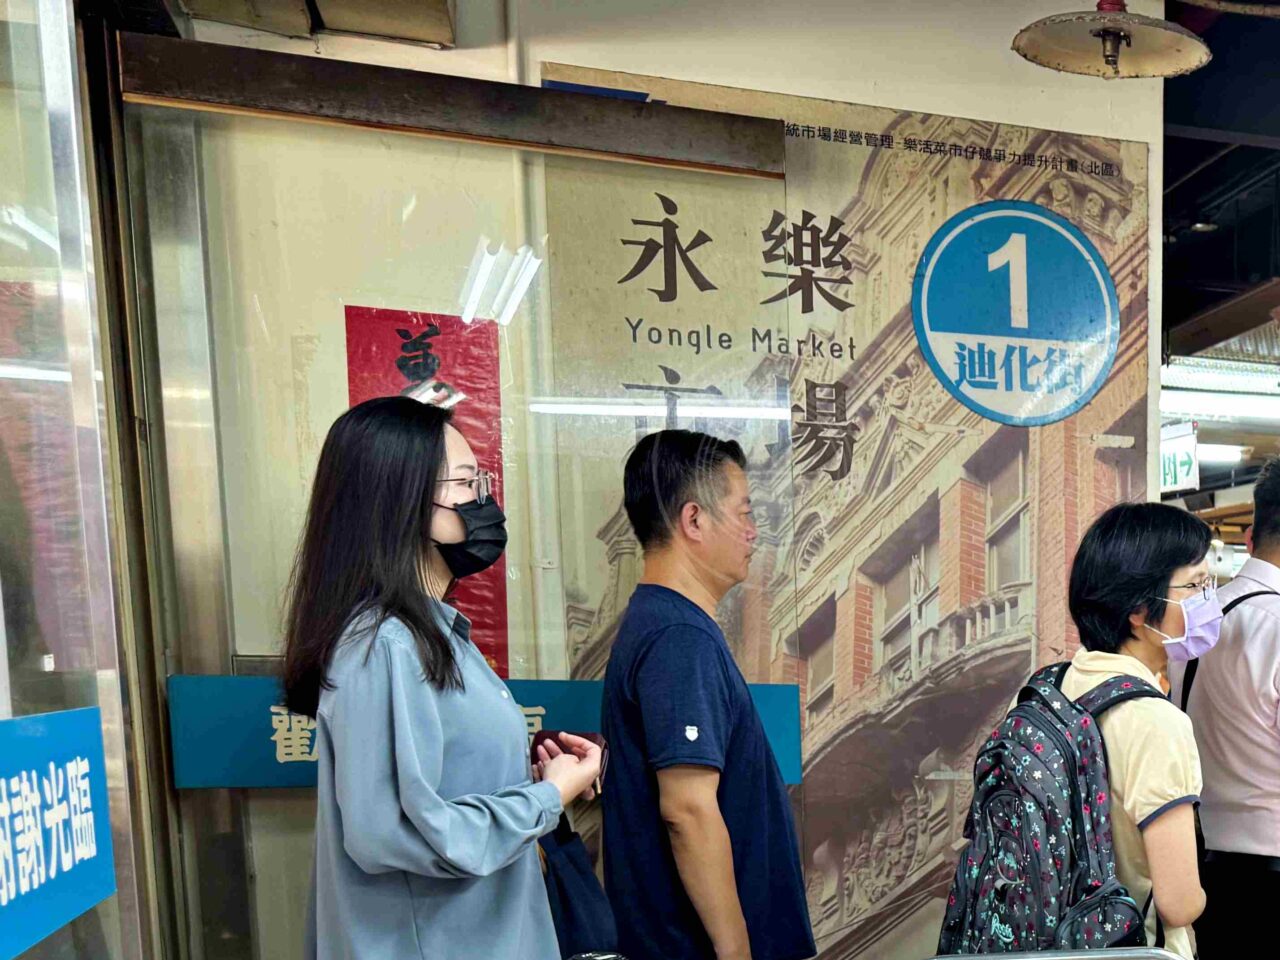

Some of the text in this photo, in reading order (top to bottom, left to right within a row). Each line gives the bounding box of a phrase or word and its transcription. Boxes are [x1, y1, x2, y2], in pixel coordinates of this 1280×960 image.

[617, 191, 856, 315] 永樂
[987, 232, 1029, 329] 1
[624, 316, 857, 361] Yongle Market
[953, 340, 1085, 396] 迪化街
